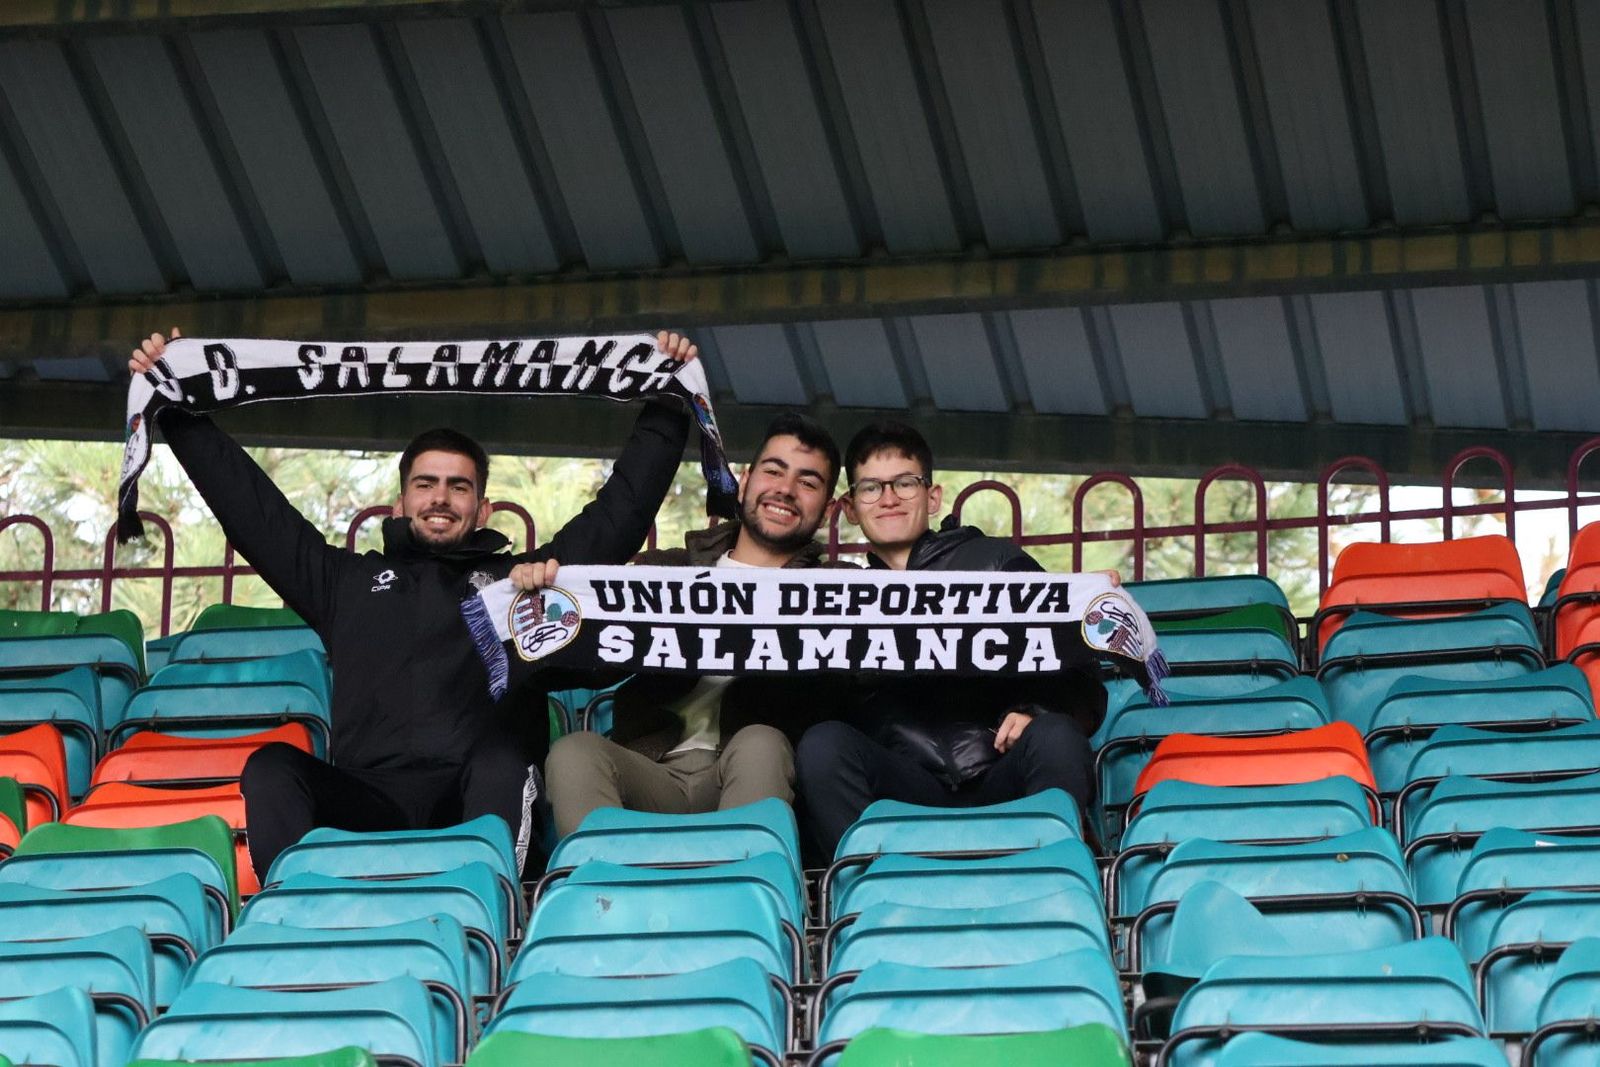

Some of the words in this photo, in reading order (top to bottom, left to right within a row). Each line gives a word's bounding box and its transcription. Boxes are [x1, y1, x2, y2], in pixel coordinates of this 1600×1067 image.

[297, 339, 686, 393] SALAMANCA
[590, 570, 756, 615] UNIÓN
[778, 582, 1070, 616] DEPORTIVA
[597, 625, 1061, 673] SALAMANCA
